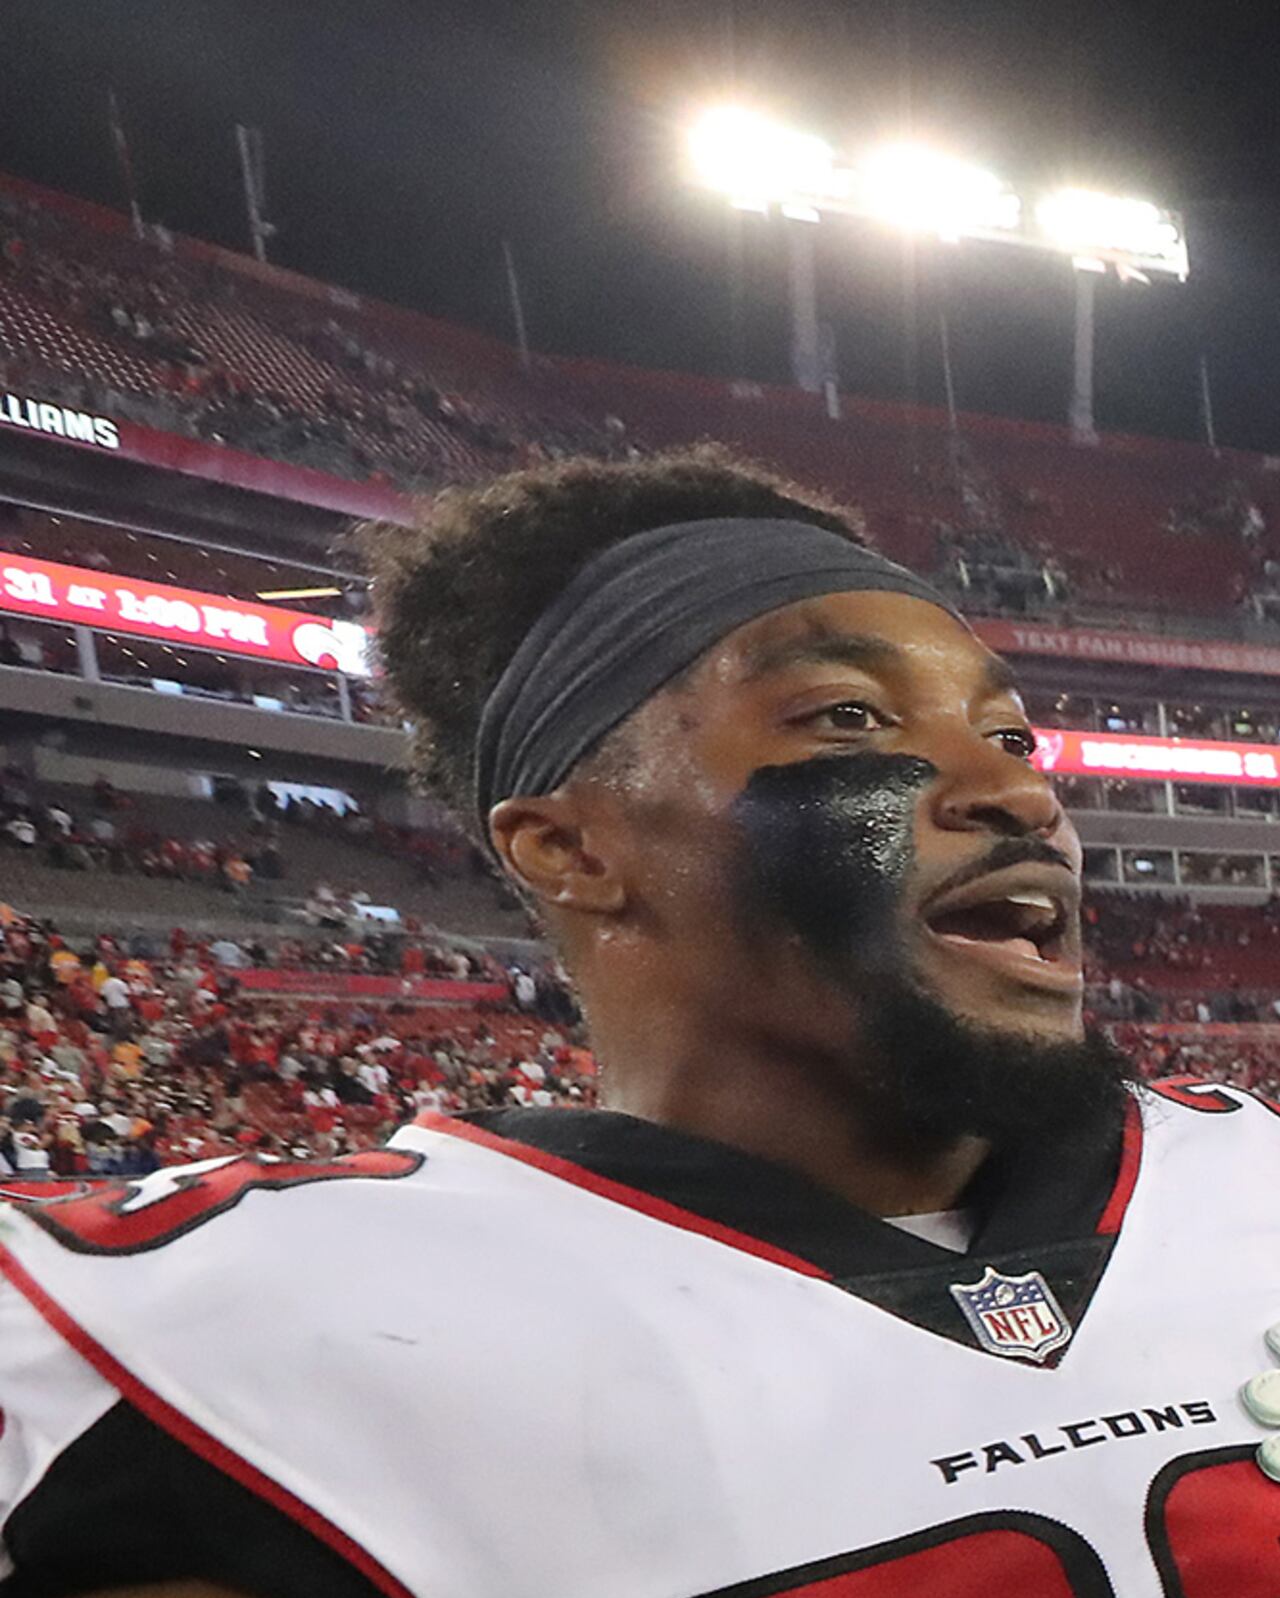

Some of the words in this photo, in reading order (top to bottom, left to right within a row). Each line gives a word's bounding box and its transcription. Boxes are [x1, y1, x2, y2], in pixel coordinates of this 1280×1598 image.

[3, 567, 58, 606] 31
[1012, 630, 1070, 652] TEXT
[983, 1304, 1056, 1344] NFL
[930, 1400, 1217, 1485] FALCONS
